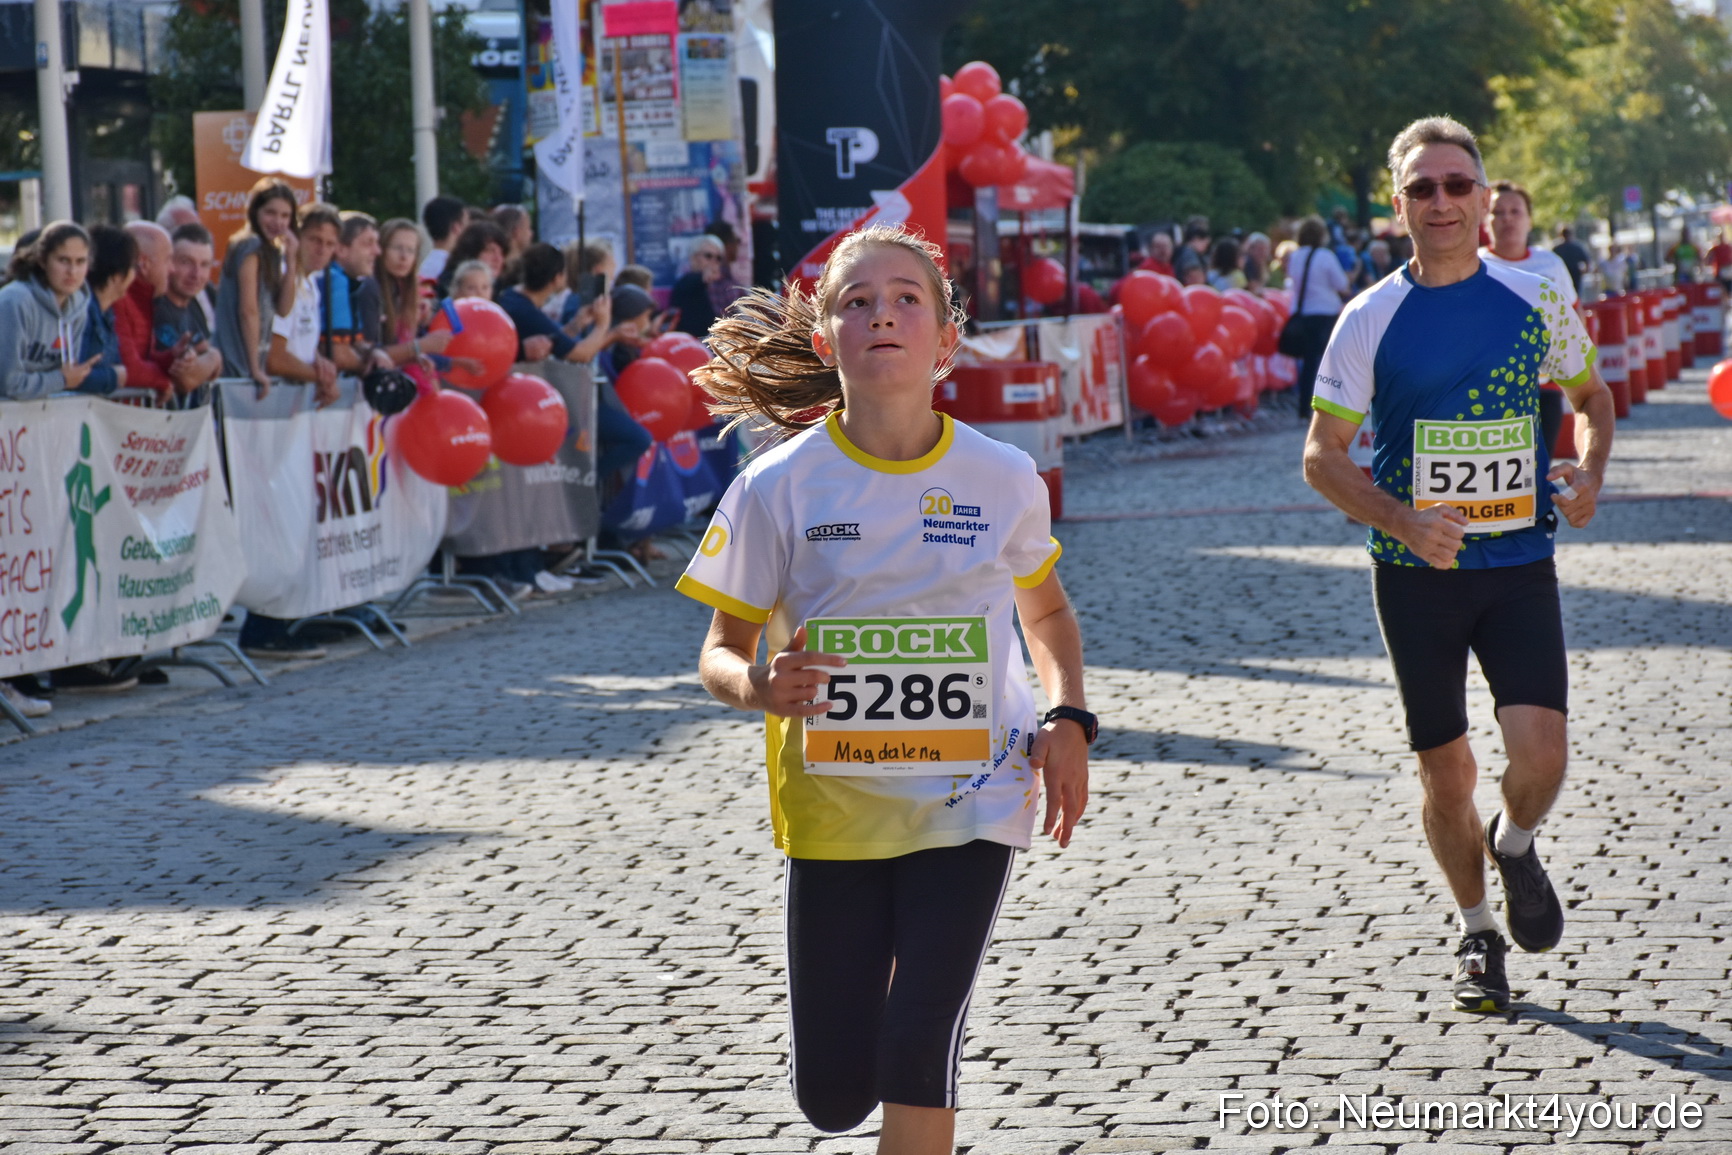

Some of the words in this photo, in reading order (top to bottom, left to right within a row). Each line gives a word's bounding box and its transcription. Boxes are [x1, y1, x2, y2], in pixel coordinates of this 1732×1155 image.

[1426, 423, 1524, 450] BOCK
[1429, 457, 1523, 494] 5212
[923, 495, 952, 515] 20
[955, 506, 979, 516] JAHRE
[1455, 503, 1516, 519] OLGER
[805, 523, 861, 539] BOCK
[923, 518, 990, 532] Neumarkter
[922, 532, 977, 548] Stadtlauf
[820, 624, 974, 657] BOCK
[826, 673, 971, 721] 5286
[976, 676, 983, 686] S
[1006, 728, 1020, 751] 2019
[834, 741, 941, 764] Magdalena
